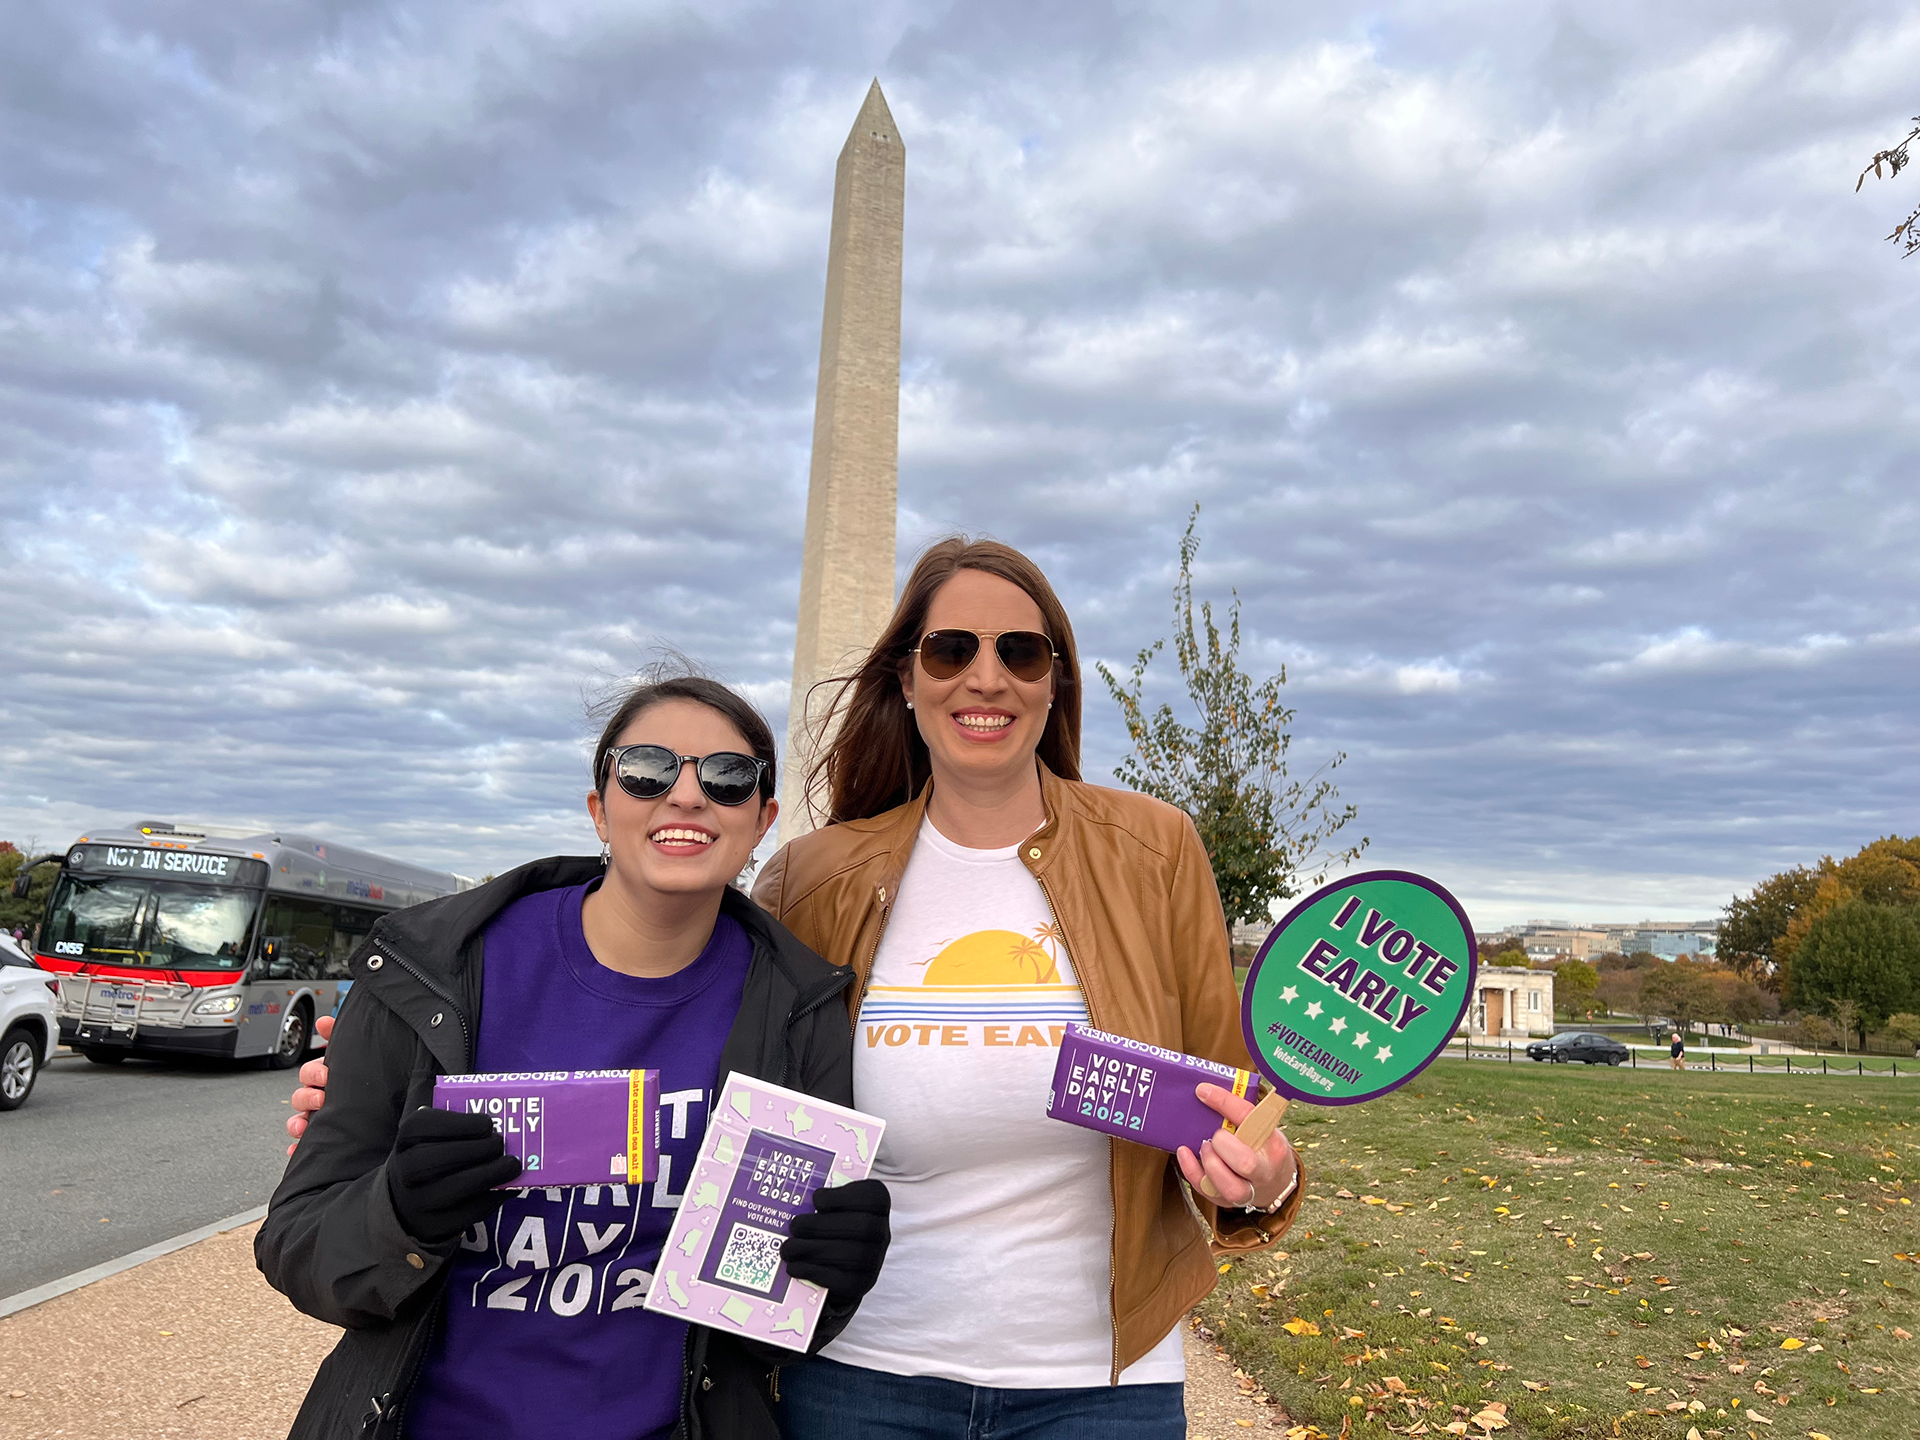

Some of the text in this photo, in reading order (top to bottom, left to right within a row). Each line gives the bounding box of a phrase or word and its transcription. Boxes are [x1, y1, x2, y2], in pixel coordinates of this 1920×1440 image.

[106, 847, 228, 875] NOT IN SERVICE
[1329, 894, 1460, 996] I VOTE
[1296, 937, 1431, 1032] EARLY
[866, 1024, 969, 1048] VOTE
[1266, 1021, 1363, 1085] #VOTEEARLYDAY
[1093, 1053, 1153, 1082] VOTE
[1272, 1045, 1336, 1092] VoteEarlyDay.org
[1068, 1081, 1113, 1104] DAY
[1072, 1065, 1150, 1098] EARLY
[469, 1097, 540, 1114] VOTE
[632, 1099, 640, 1134] caramel
[1080, 1102, 1141, 1130] 2022
[492, 1116, 541, 1133] RLY
[631, 1136, 639, 1151] sea
[632, 1153, 640, 1170] salt
[757, 1159, 810, 1183] EARLY
[773, 1150, 813, 1172] VOTE
[753, 1170, 785, 1188] DAY
[760, 1186, 802, 1206] 2022
[732, 1197, 748, 1208] FIND
[748, 1202, 762, 1212] OUT
[762, 1206, 777, 1216] HOW
[778, 1210, 792, 1220] YOU
[747, 1211, 764, 1222] VOTE
[764, 1216, 785, 1228] EARLY
[486, 1263, 654, 1318] 202
